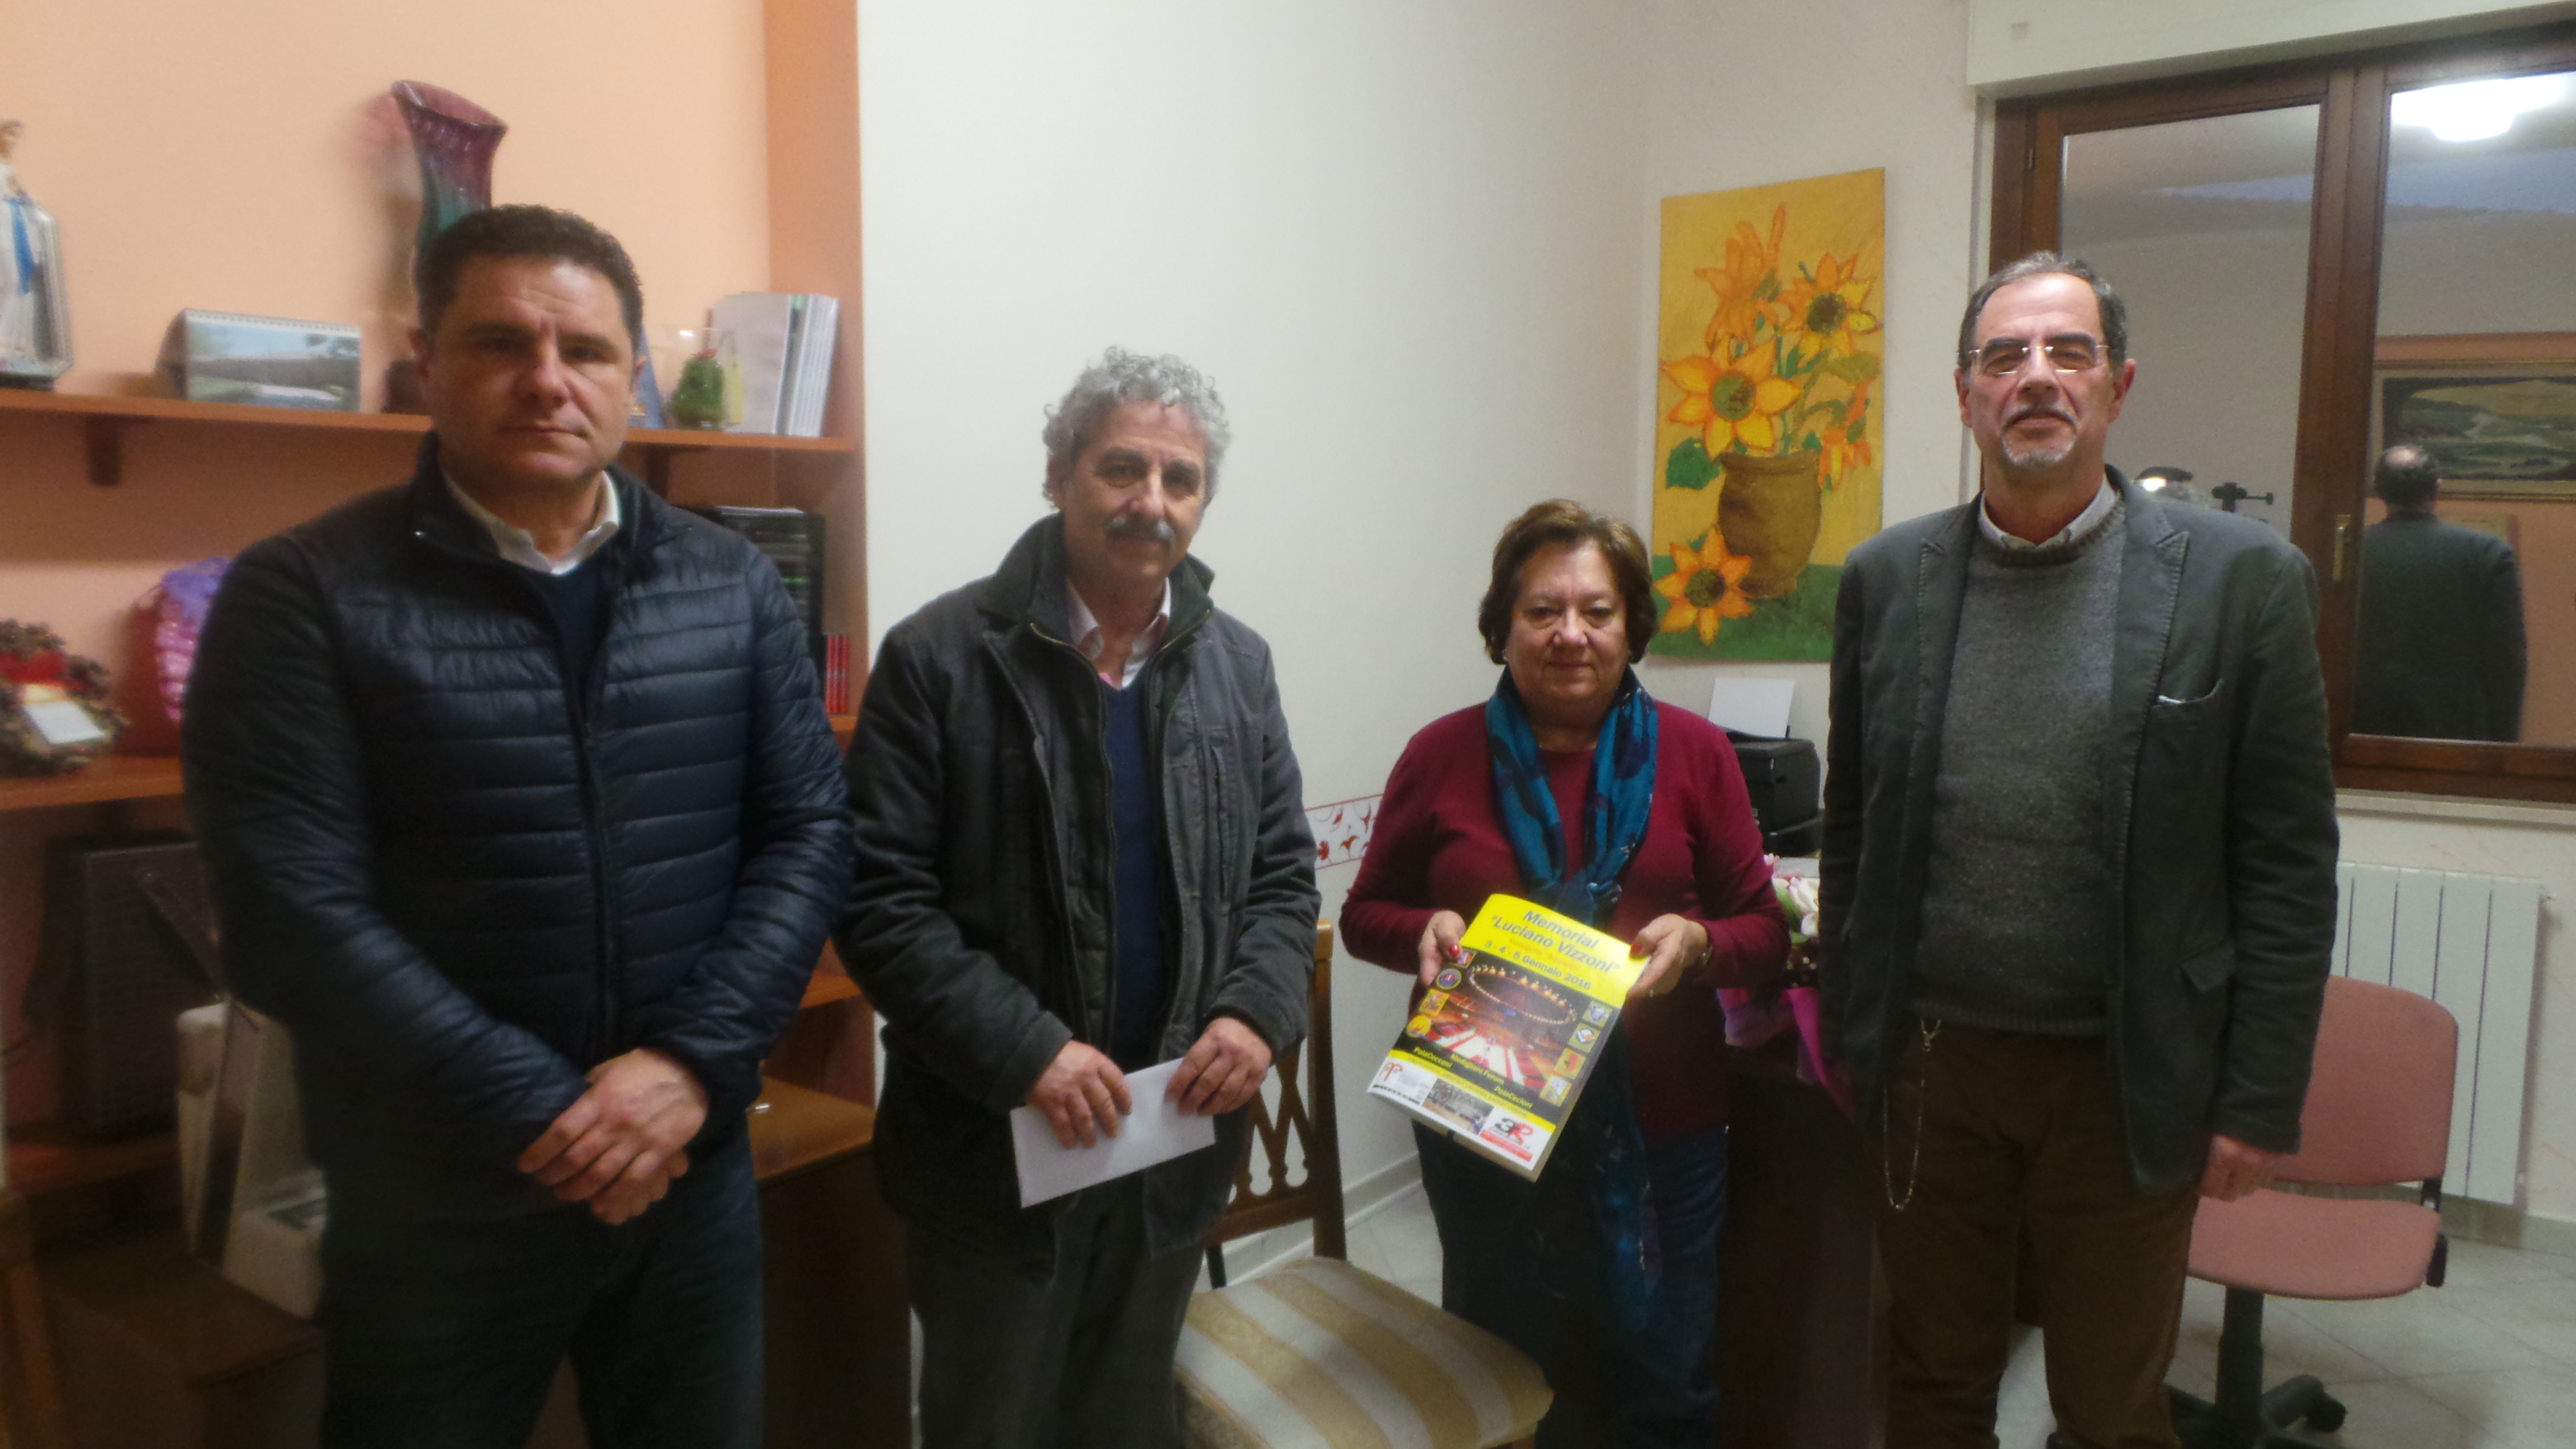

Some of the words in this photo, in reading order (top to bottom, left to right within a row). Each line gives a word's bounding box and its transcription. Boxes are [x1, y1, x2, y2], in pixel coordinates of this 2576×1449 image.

[1522, 910, 1600, 949] Memorial
[1485, 940, 1492, 949] 3
[1513, 951, 1520, 959] 5
[1522, 954, 1561, 978] Gennaio
[1564, 973, 1592, 989] 2016
[1483, 1069, 1505, 1085] Forum
